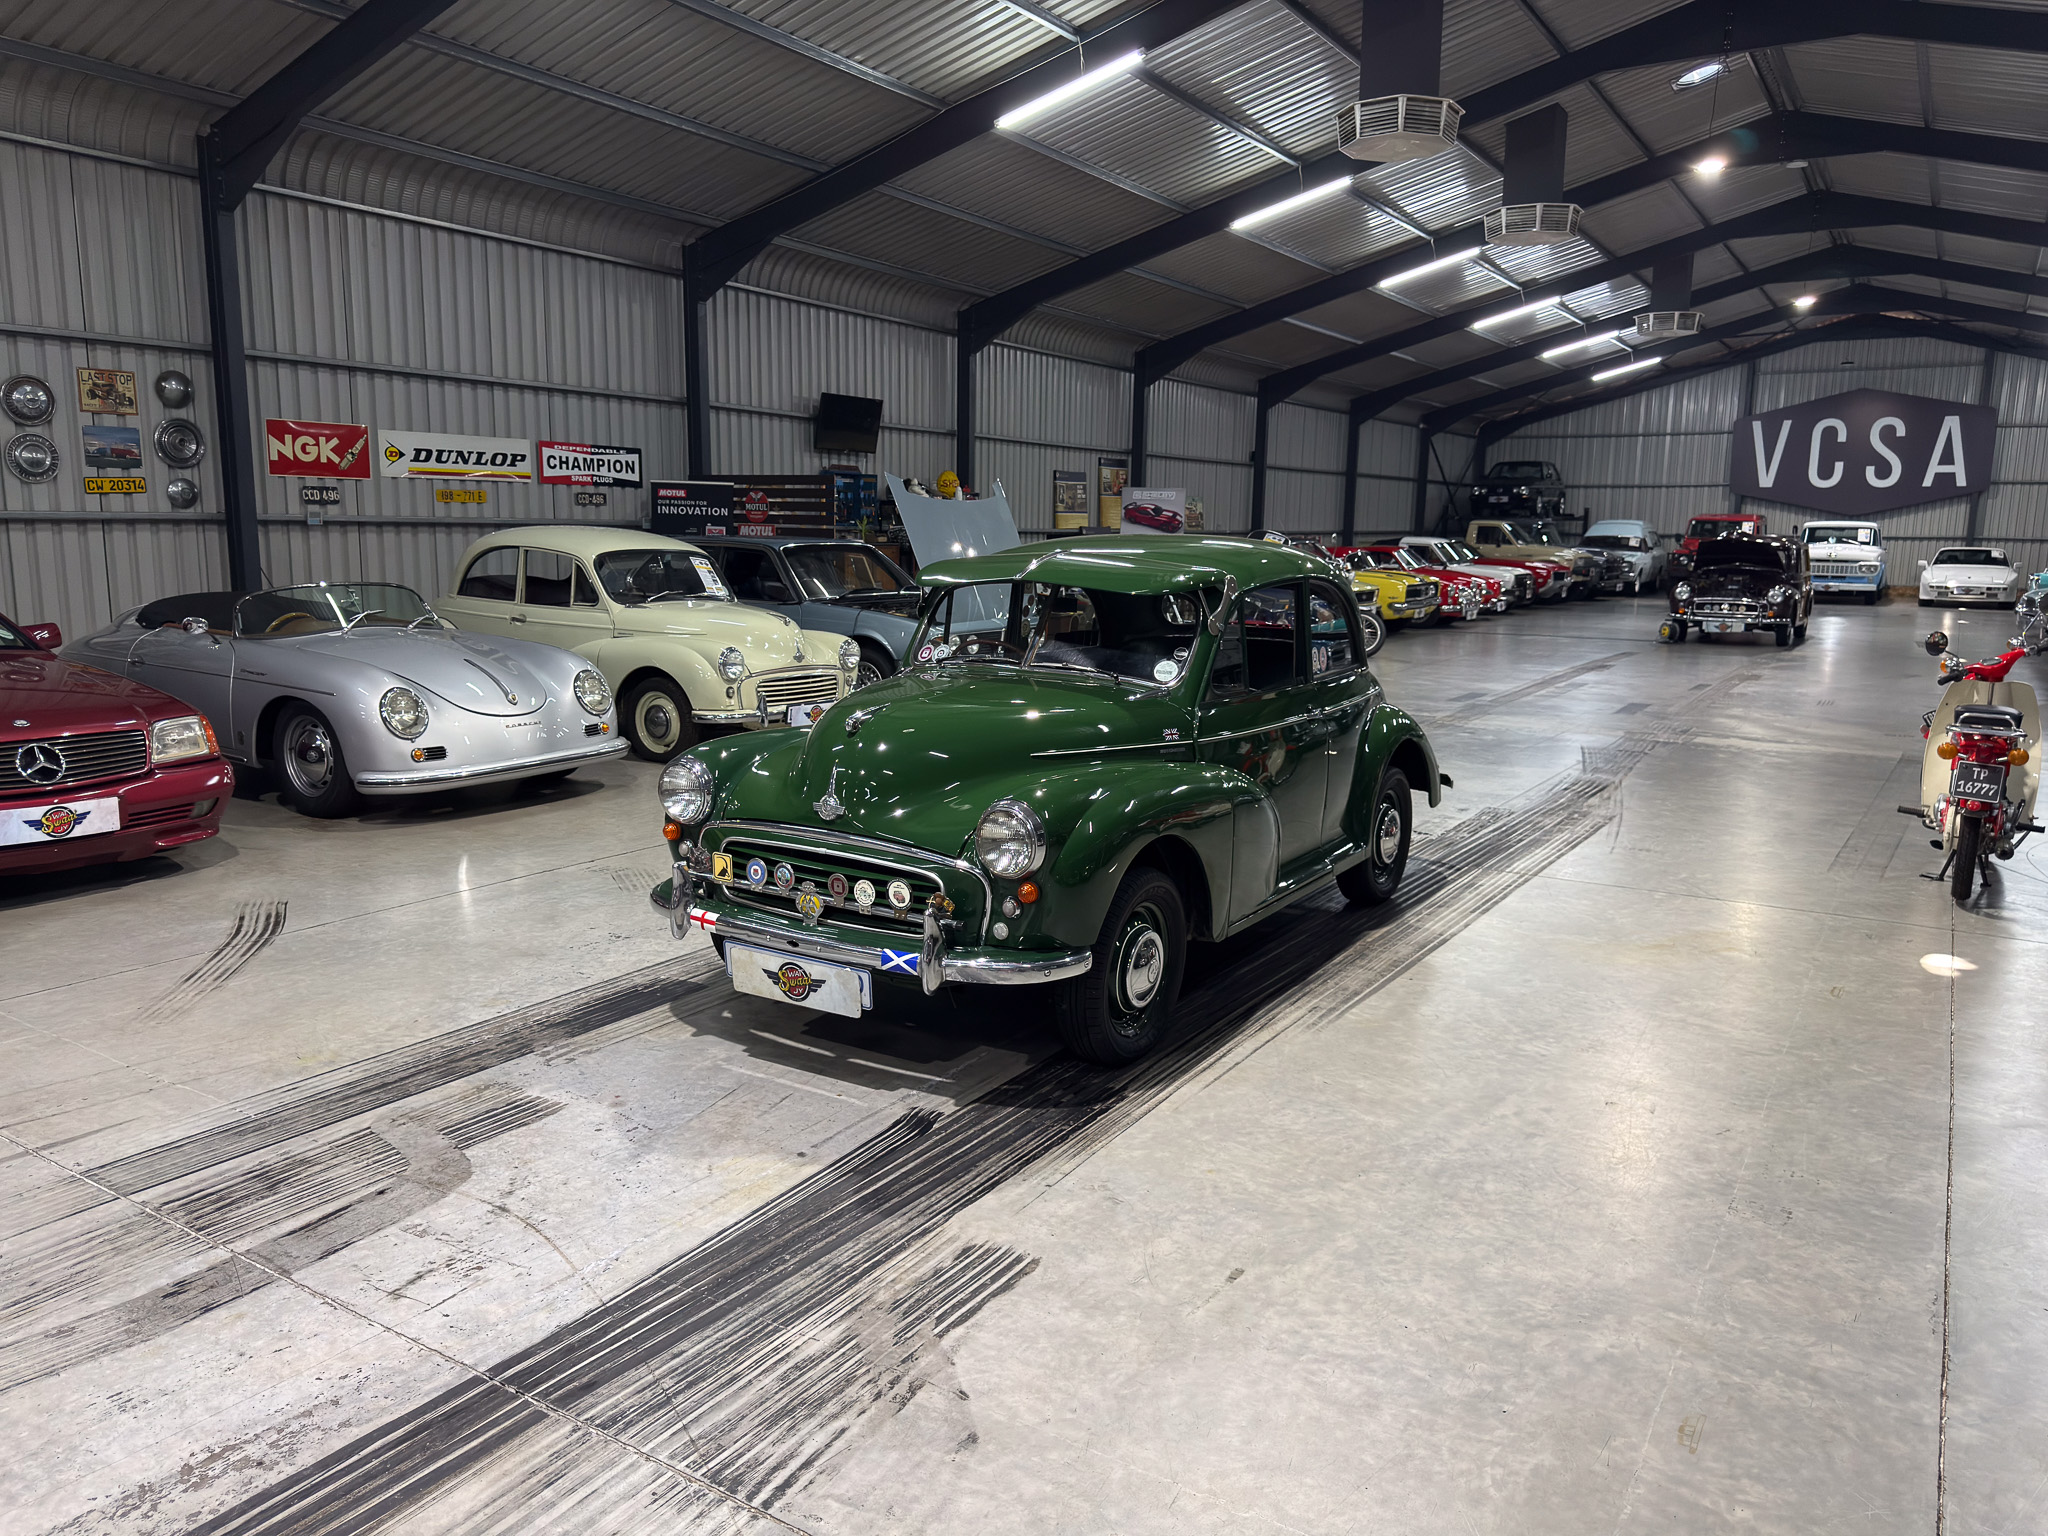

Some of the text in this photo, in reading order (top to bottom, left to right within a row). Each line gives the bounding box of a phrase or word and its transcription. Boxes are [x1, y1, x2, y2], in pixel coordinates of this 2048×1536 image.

[80, 371, 132, 386] LAST STOP
[268, 434, 341, 465] NGK
[554, 445, 627, 454] DEPENDABLE
[1752, 415, 1968, 489] VCSA
[410, 447, 527, 467] DUNLOP
[546, 454, 636, 474] CHAMPION
[87, 479, 145, 491] CW 20314
[302, 489, 340, 501] CCD 496
[659, 489, 686, 497] MOTUL
[657, 505, 729, 516] INNOVATION
[745, 503, 768, 511] MOTUL
[740, 525, 774, 536] MOTUL
[1972, 767, 1989, 780] TP
[1956, 780, 1998, 796] 16777
